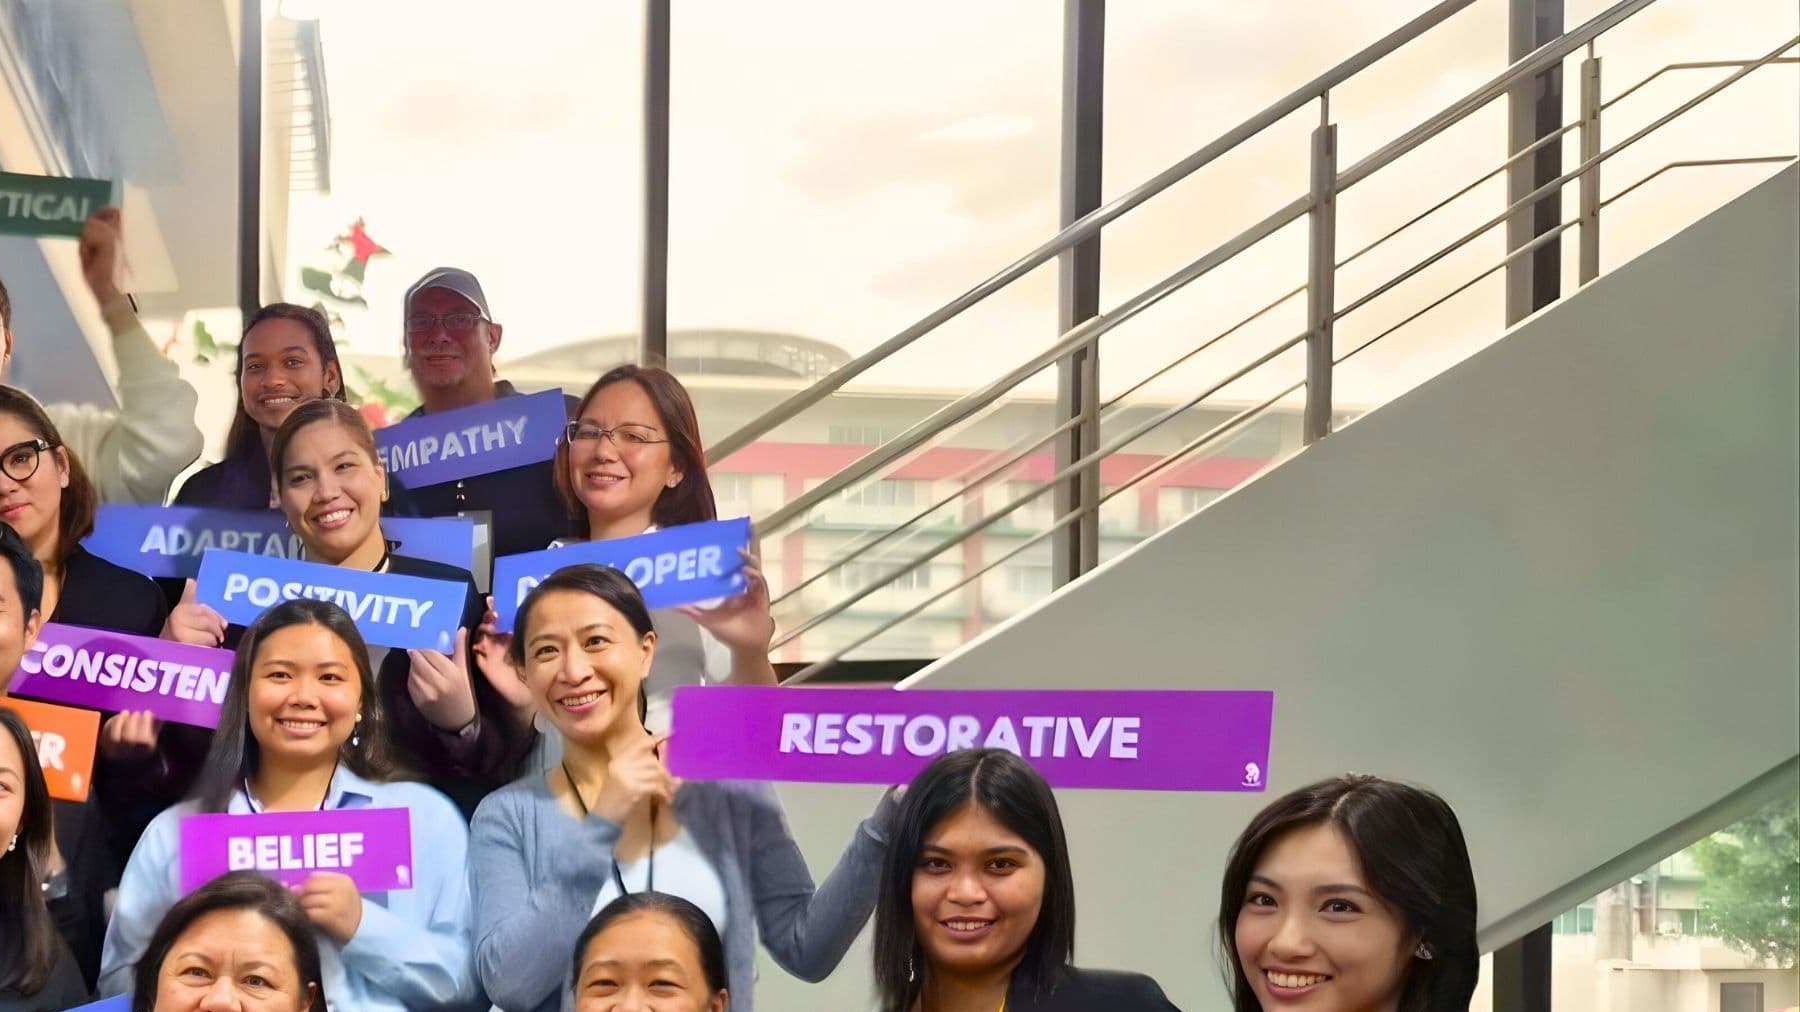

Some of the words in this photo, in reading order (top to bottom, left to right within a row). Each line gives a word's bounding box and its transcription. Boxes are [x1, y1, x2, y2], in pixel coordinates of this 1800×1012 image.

[20, 641, 231, 704] CONSISTEN
[779, 712, 1141, 759] RESTORATIVE
[228, 832, 364, 871] BELIEF
